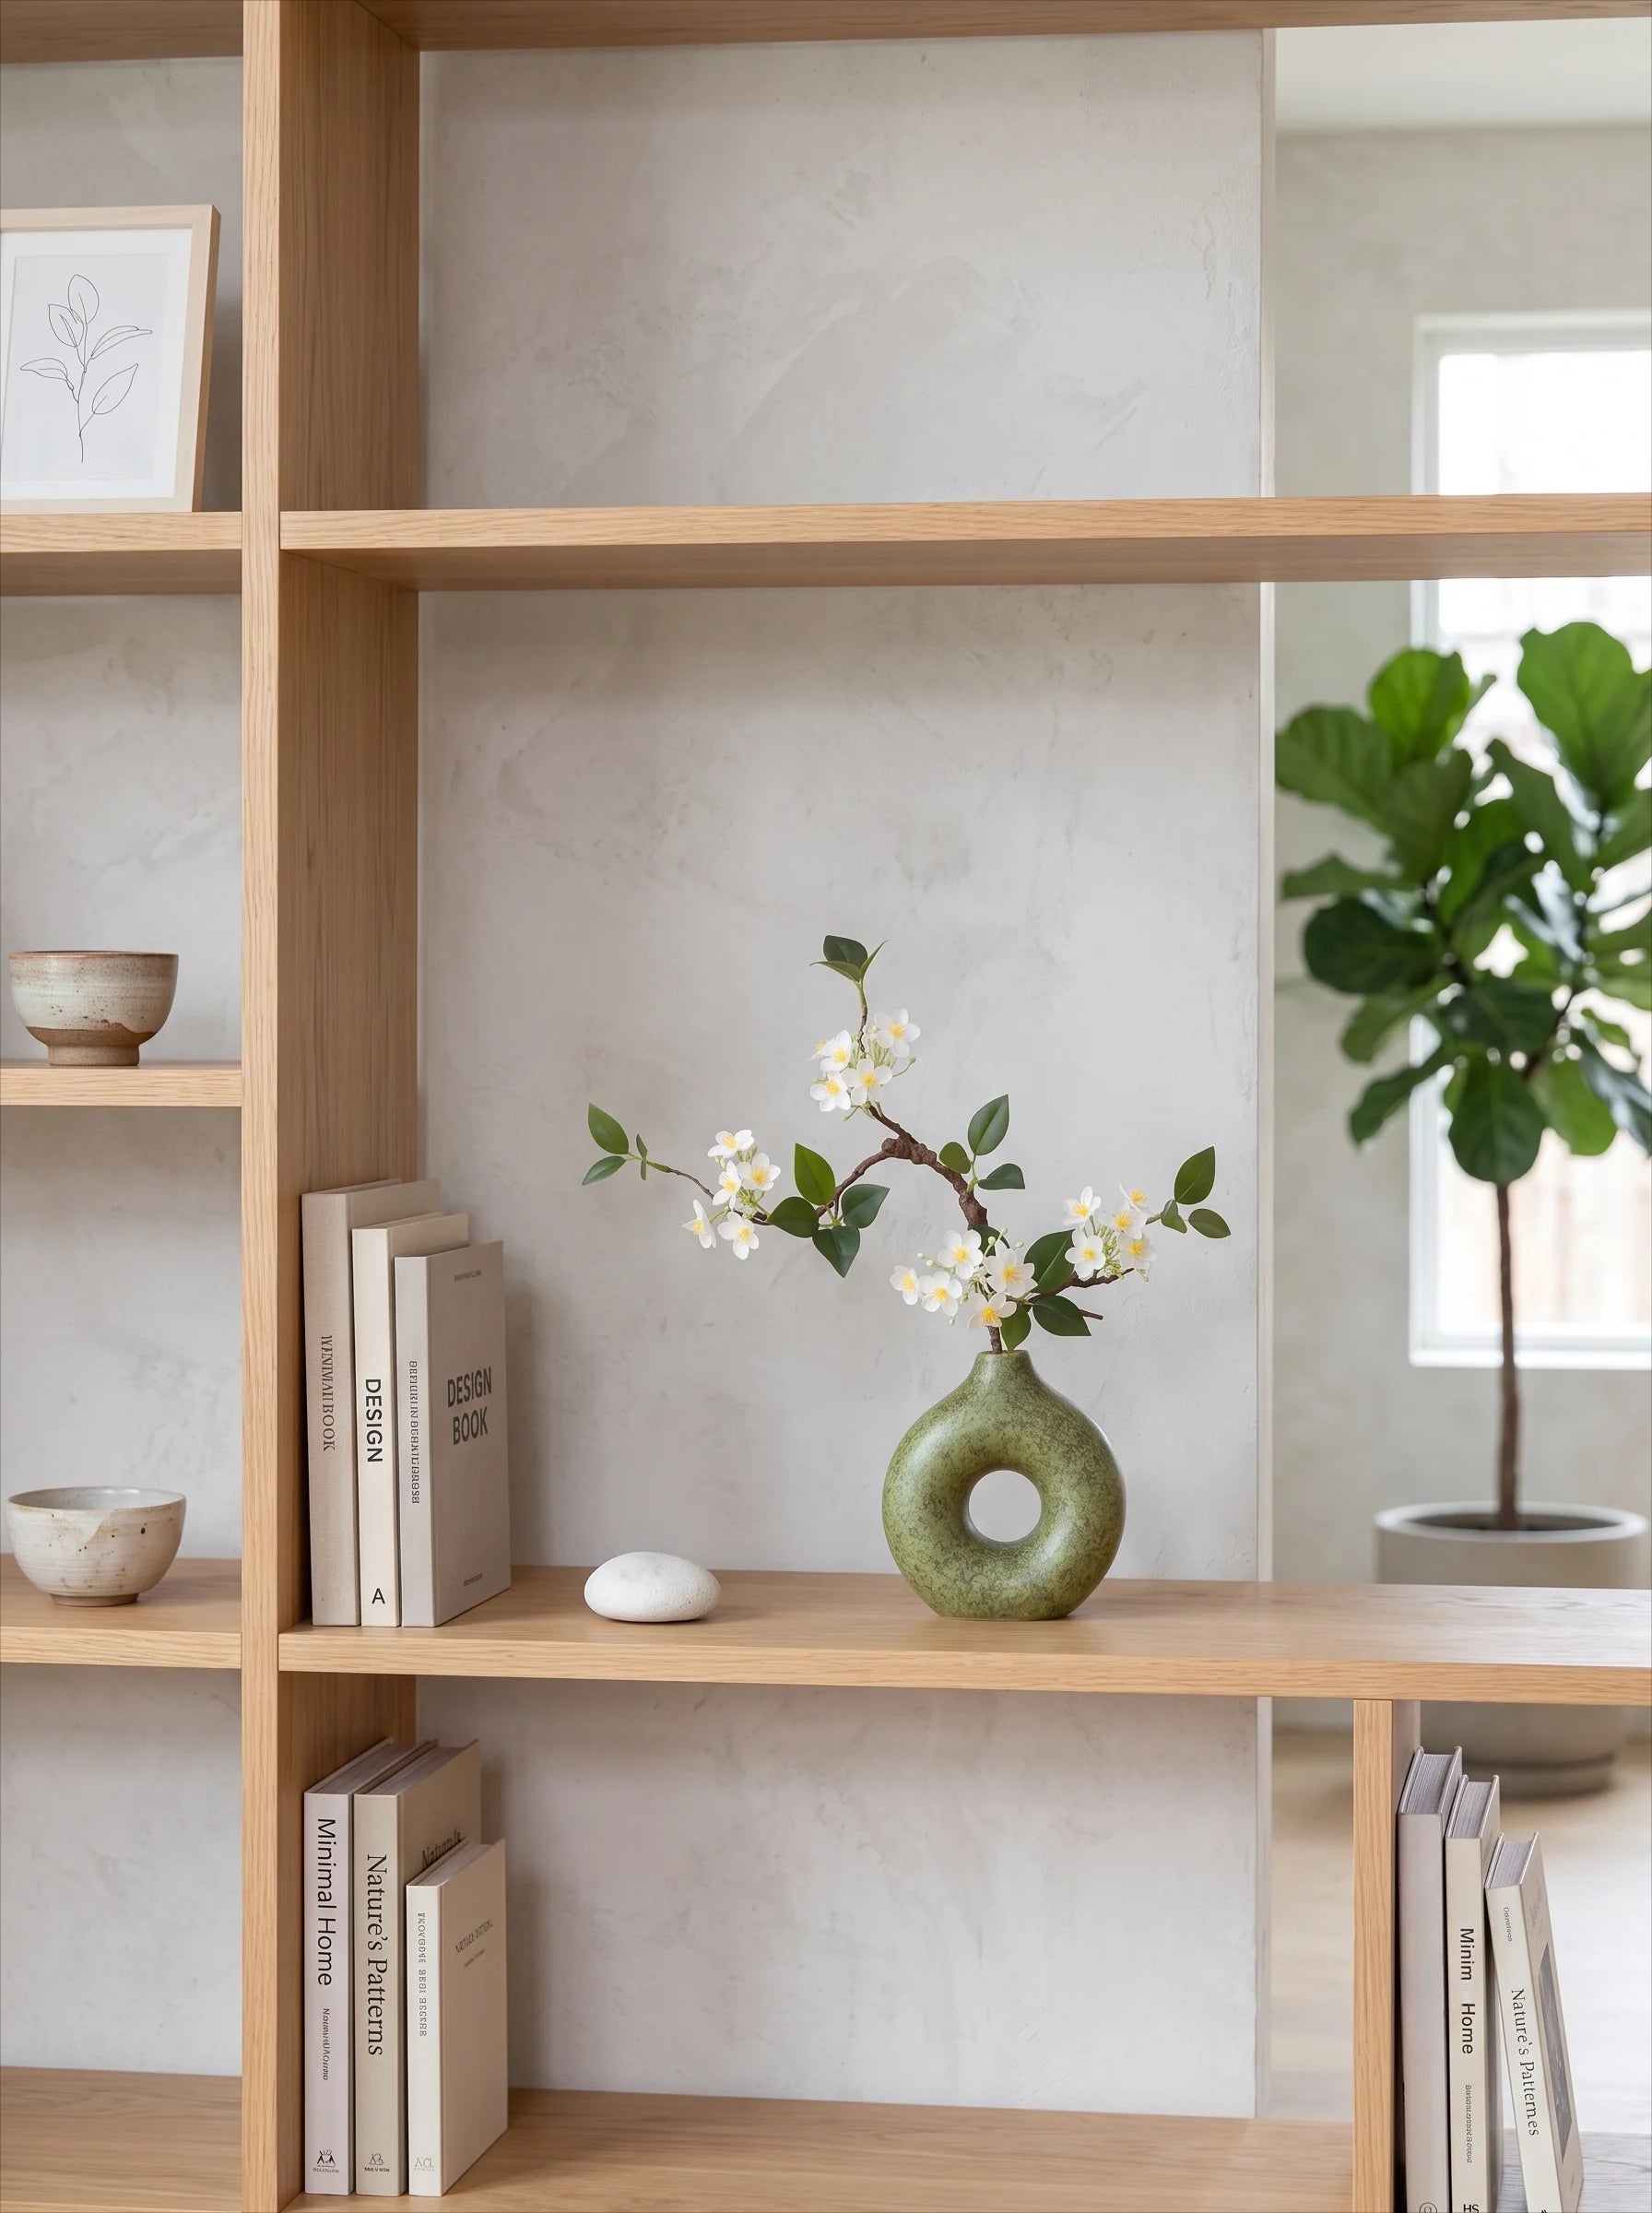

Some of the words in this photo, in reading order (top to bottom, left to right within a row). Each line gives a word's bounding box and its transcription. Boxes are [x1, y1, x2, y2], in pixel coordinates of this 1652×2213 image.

[365, 1379, 384, 1462] DESIGN
[447, 1367, 492, 1408] DESIGN
[322, 1403, 336, 1451] BOOK
[453, 1406, 489, 1446] BOOK
[372, 1588, 385, 1604] A
[317, 1818, 337, 1910] Minimal
[367, 1854, 388, 1951] Nature's
[317, 1917, 336, 1986] Home
[1459, 1928, 1475, 1981] Minim
[367, 1959, 388, 2055] Patterns
[1461, 2003, 1476, 2054] Home
[1511, 1988, 1533, 2055] Nature's
[1519, 2061, 1540, 2136] Patternes
